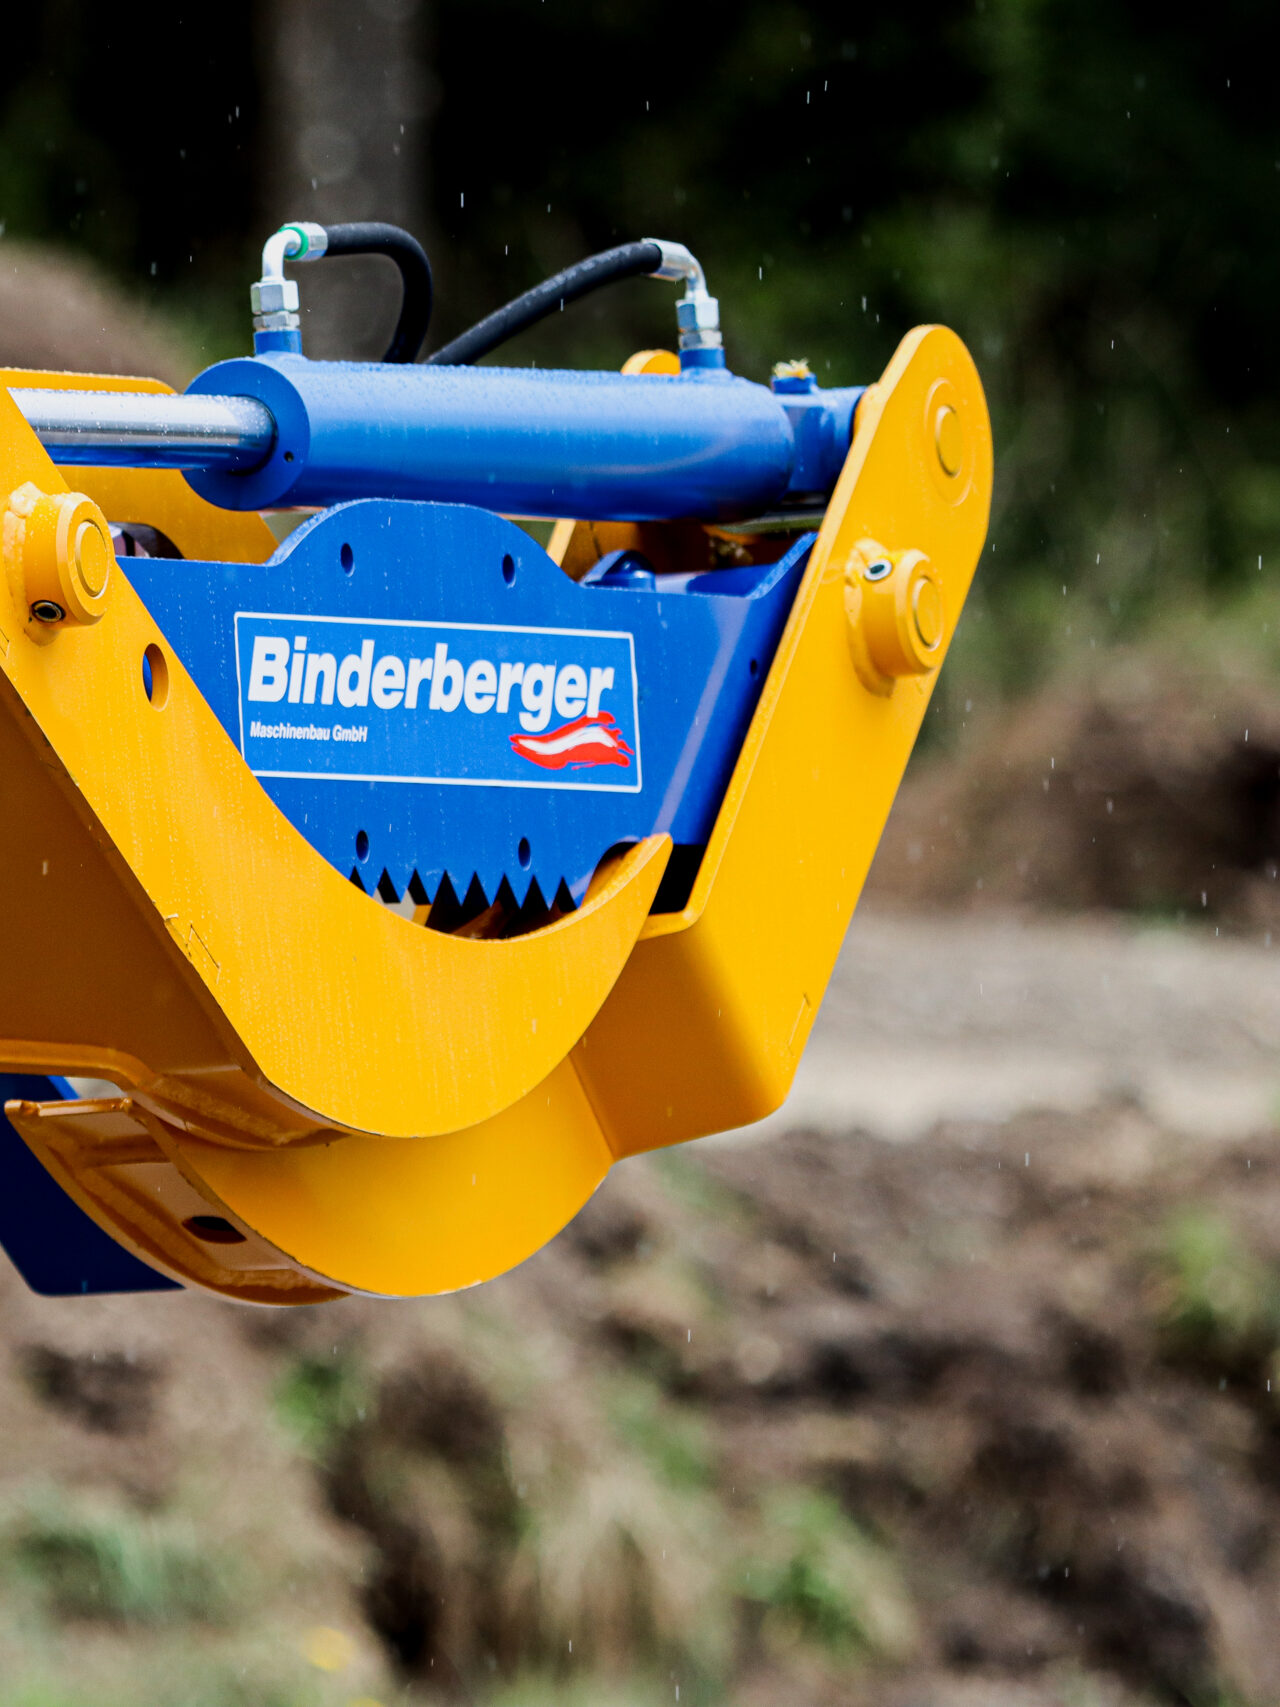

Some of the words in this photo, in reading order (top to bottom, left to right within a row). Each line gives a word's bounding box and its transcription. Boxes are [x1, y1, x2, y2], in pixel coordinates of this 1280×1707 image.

[248, 636, 614, 732] Binderberger
[250, 721, 331, 741] Maschinenbau
[332, 724, 368, 742] GmbH
